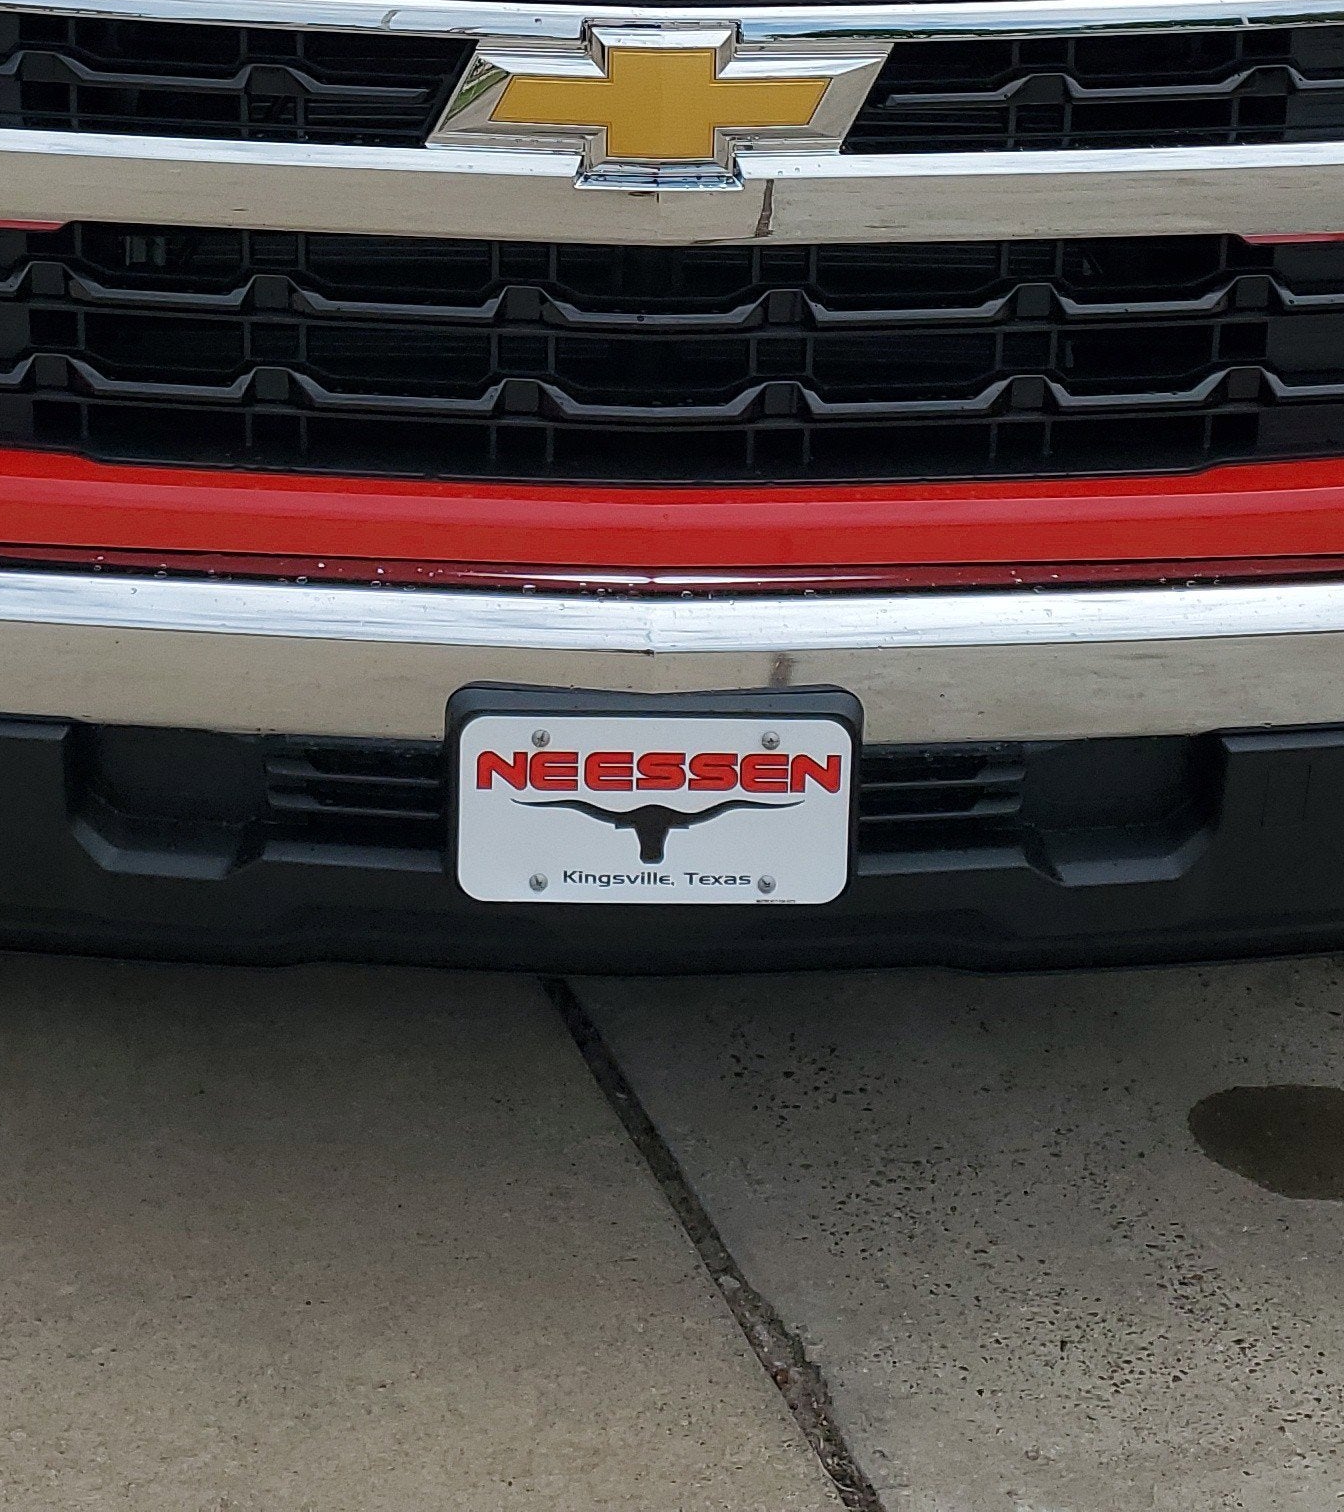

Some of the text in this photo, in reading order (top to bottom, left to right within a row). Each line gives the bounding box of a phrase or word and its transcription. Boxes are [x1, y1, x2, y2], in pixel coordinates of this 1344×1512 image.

[476, 750, 842, 794] NEESSEN
[563, 870, 752, 888] Kingsville, Texas
